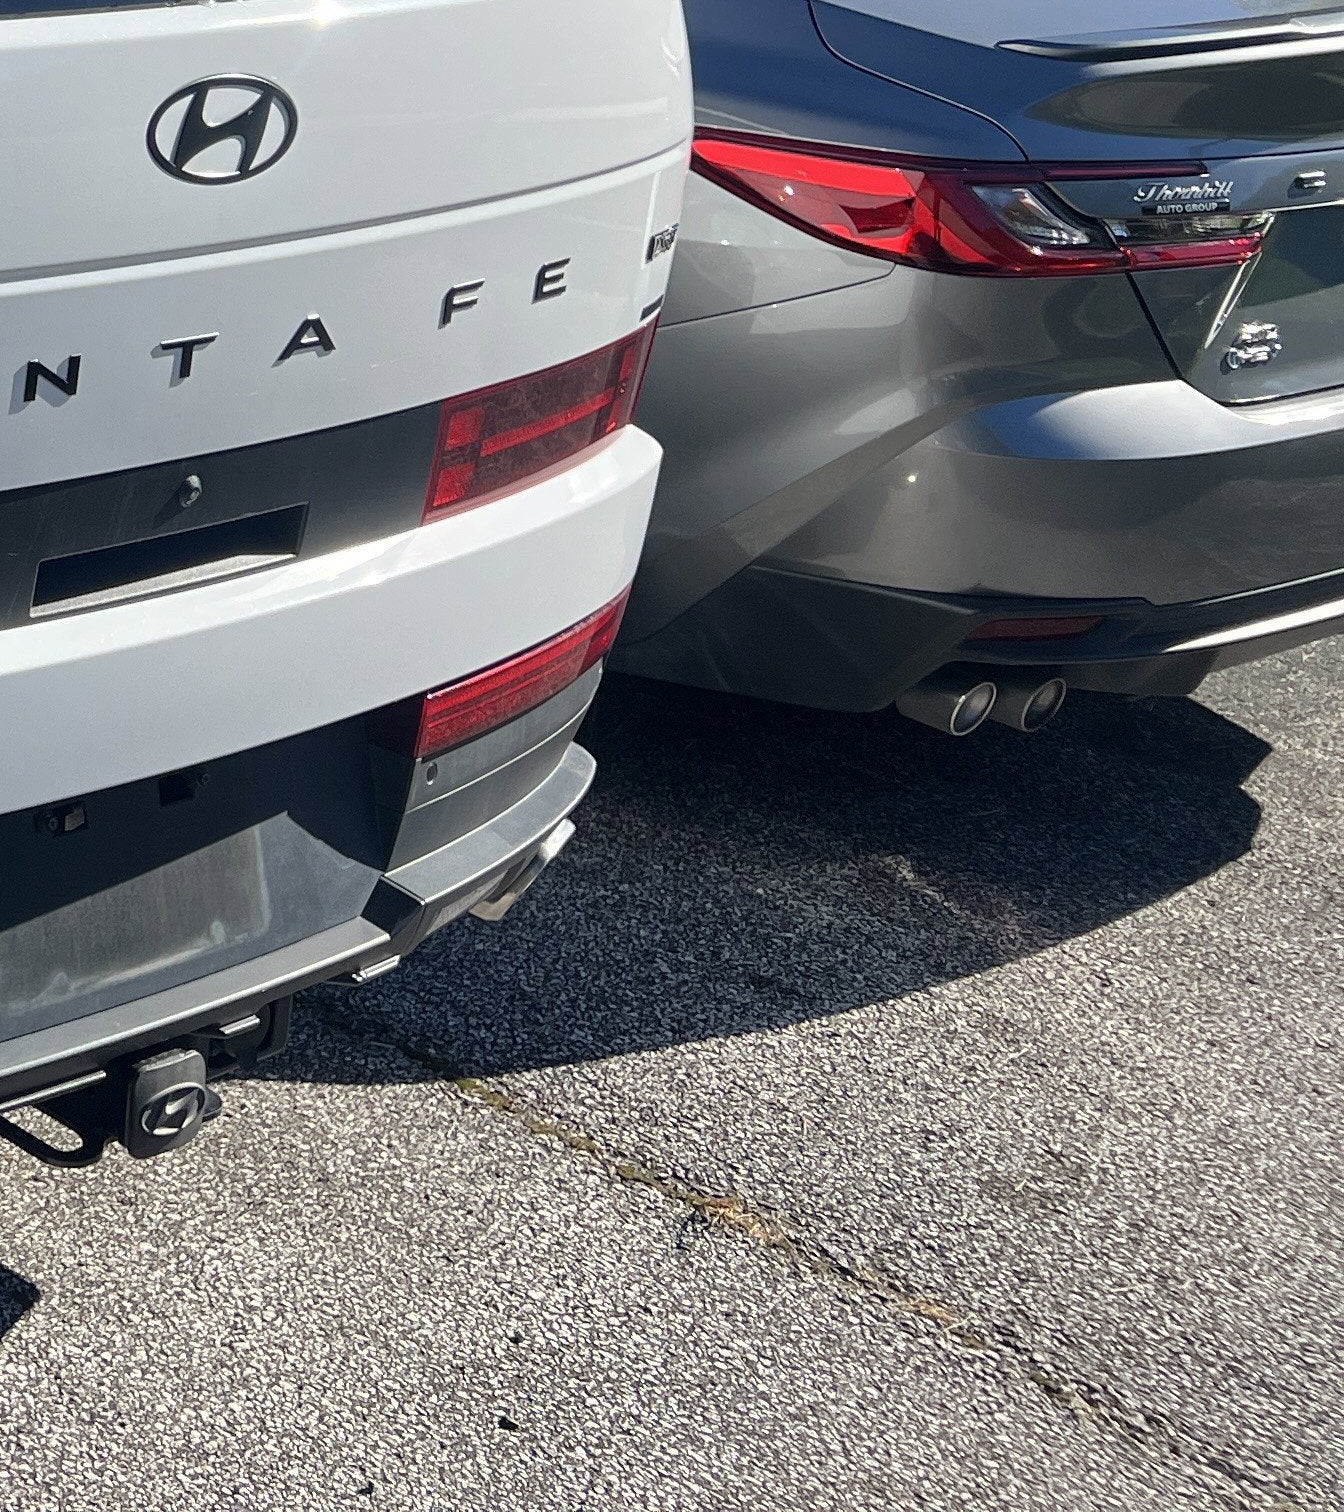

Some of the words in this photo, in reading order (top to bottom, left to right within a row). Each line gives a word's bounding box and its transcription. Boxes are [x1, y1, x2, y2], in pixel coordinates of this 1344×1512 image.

[1156, 204, 1184, 214] AUTO
[1185, 202, 1218, 213] GROUP
[438, 256, 571, 330] FE
